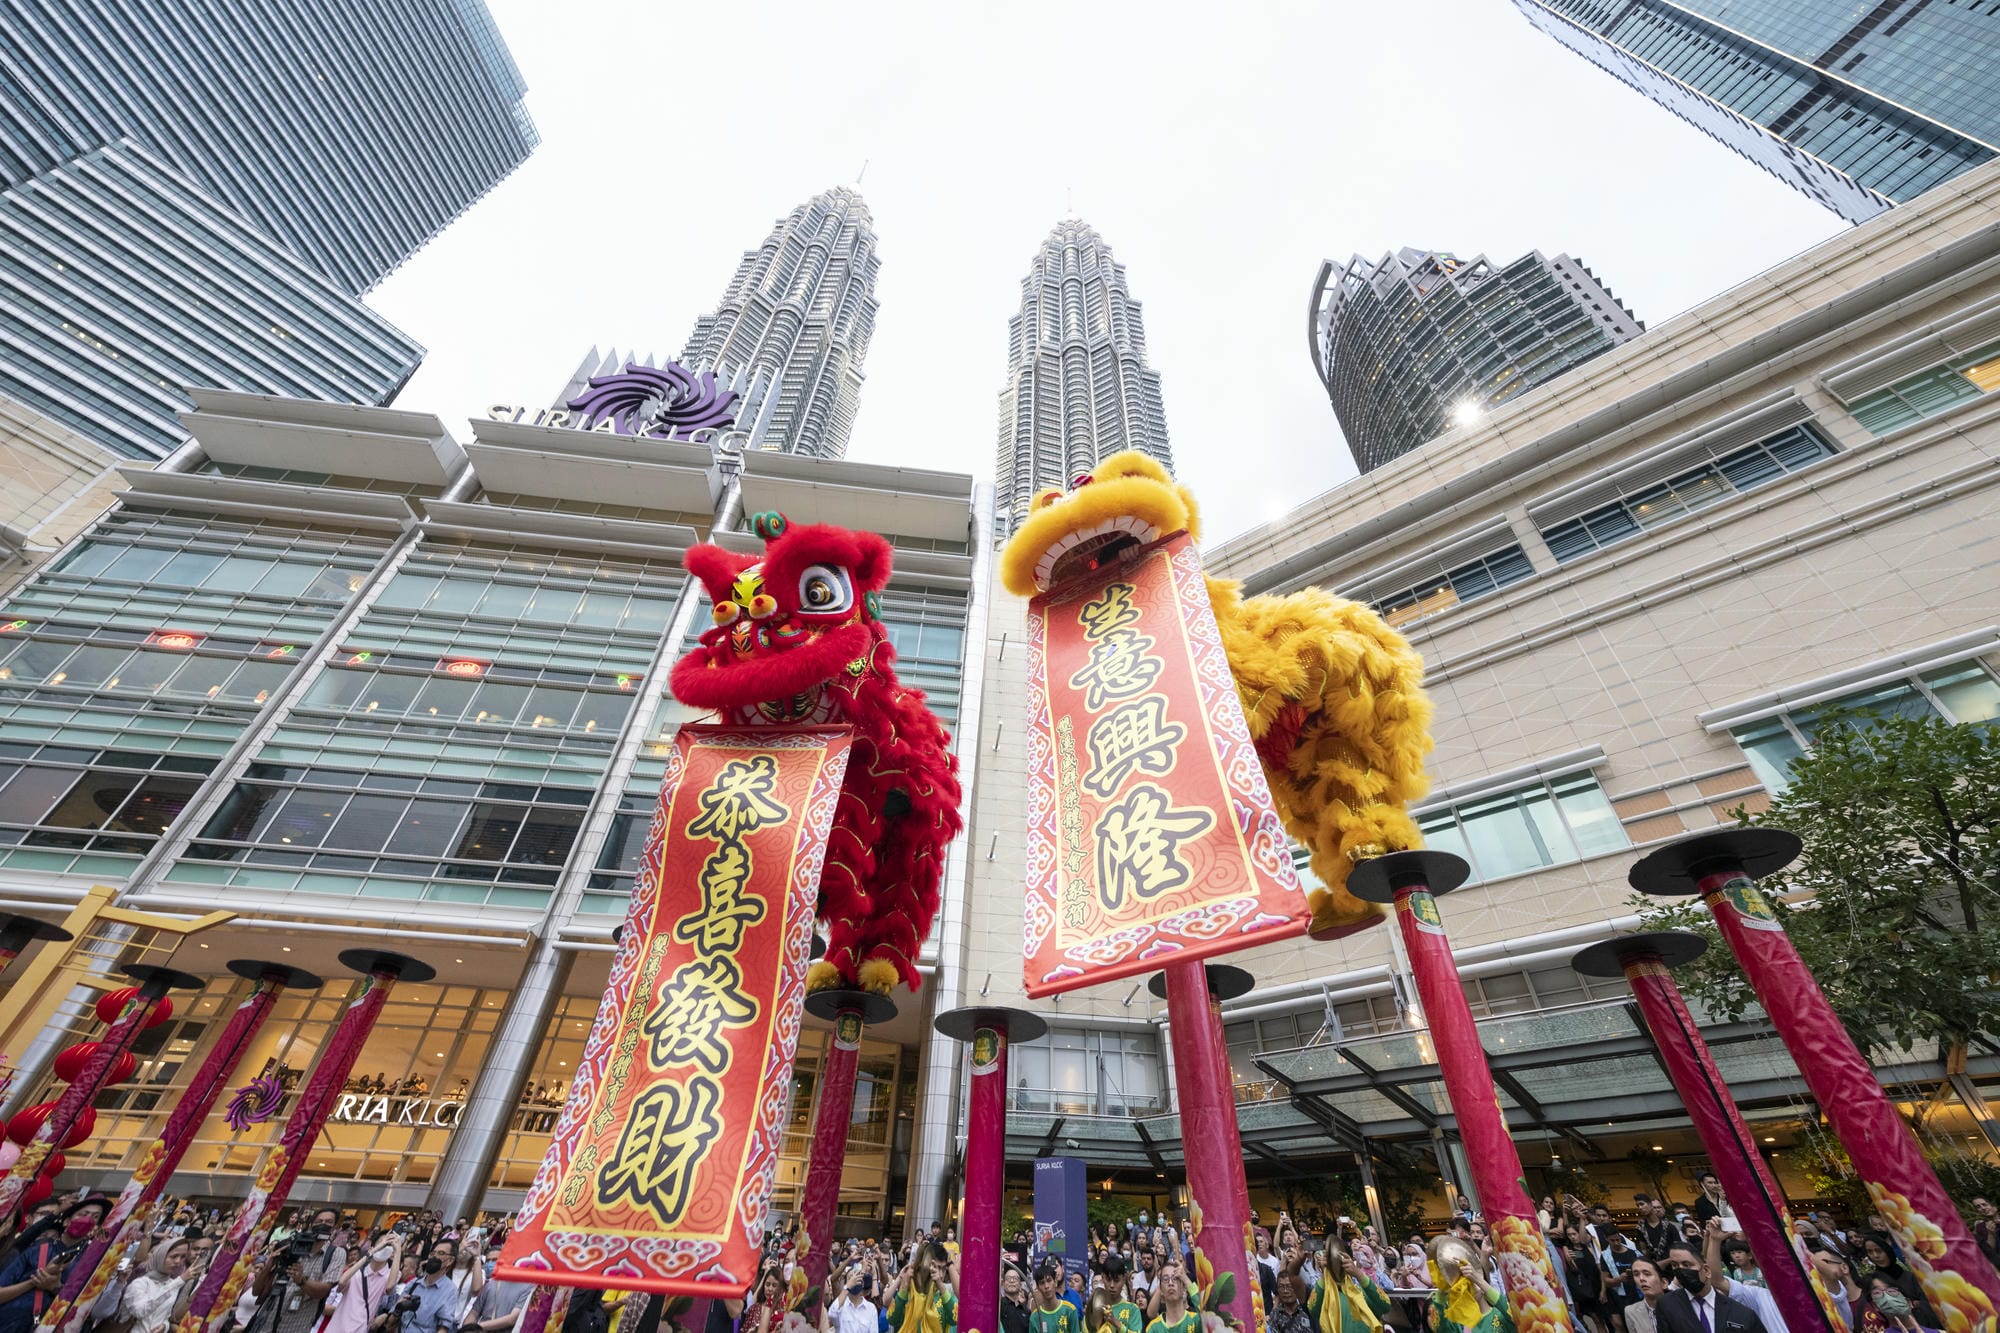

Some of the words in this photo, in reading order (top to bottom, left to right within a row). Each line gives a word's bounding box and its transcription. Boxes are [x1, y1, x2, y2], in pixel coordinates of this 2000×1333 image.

[1068, 582, 1217, 914] 生意興隆
[328, 1093, 389, 1123] RIA
[594, 754, 790, 1229] 恭喜發財
